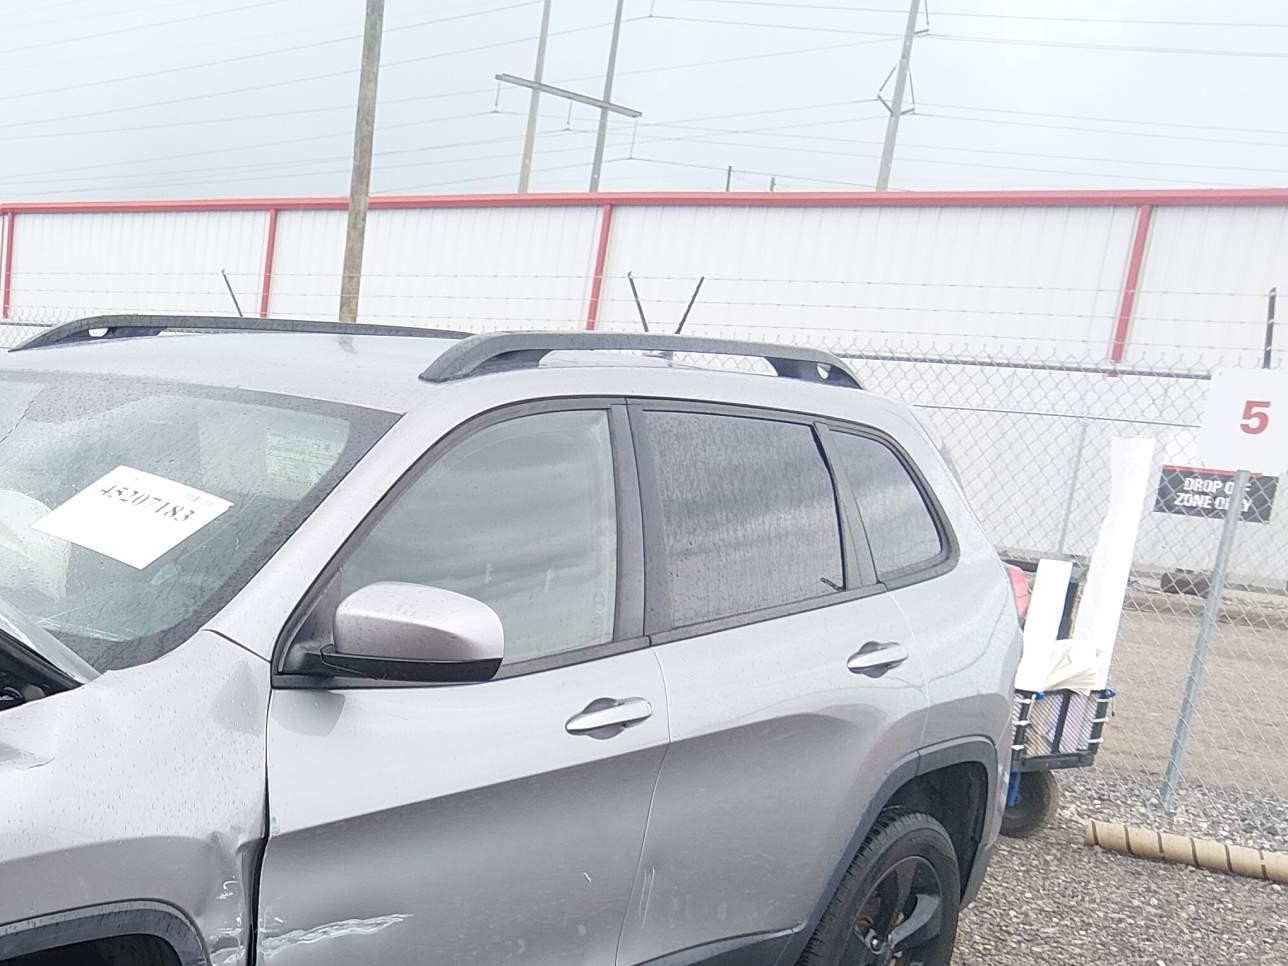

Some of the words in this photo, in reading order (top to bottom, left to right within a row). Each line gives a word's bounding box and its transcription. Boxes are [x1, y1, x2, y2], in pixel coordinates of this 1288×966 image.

[1240, 400, 1271, 434] 5
[1184, 477, 1223, 494] DROP
[100, 484, 196, 522] 45207183
[1174, 492, 1212, 509] ZONE
